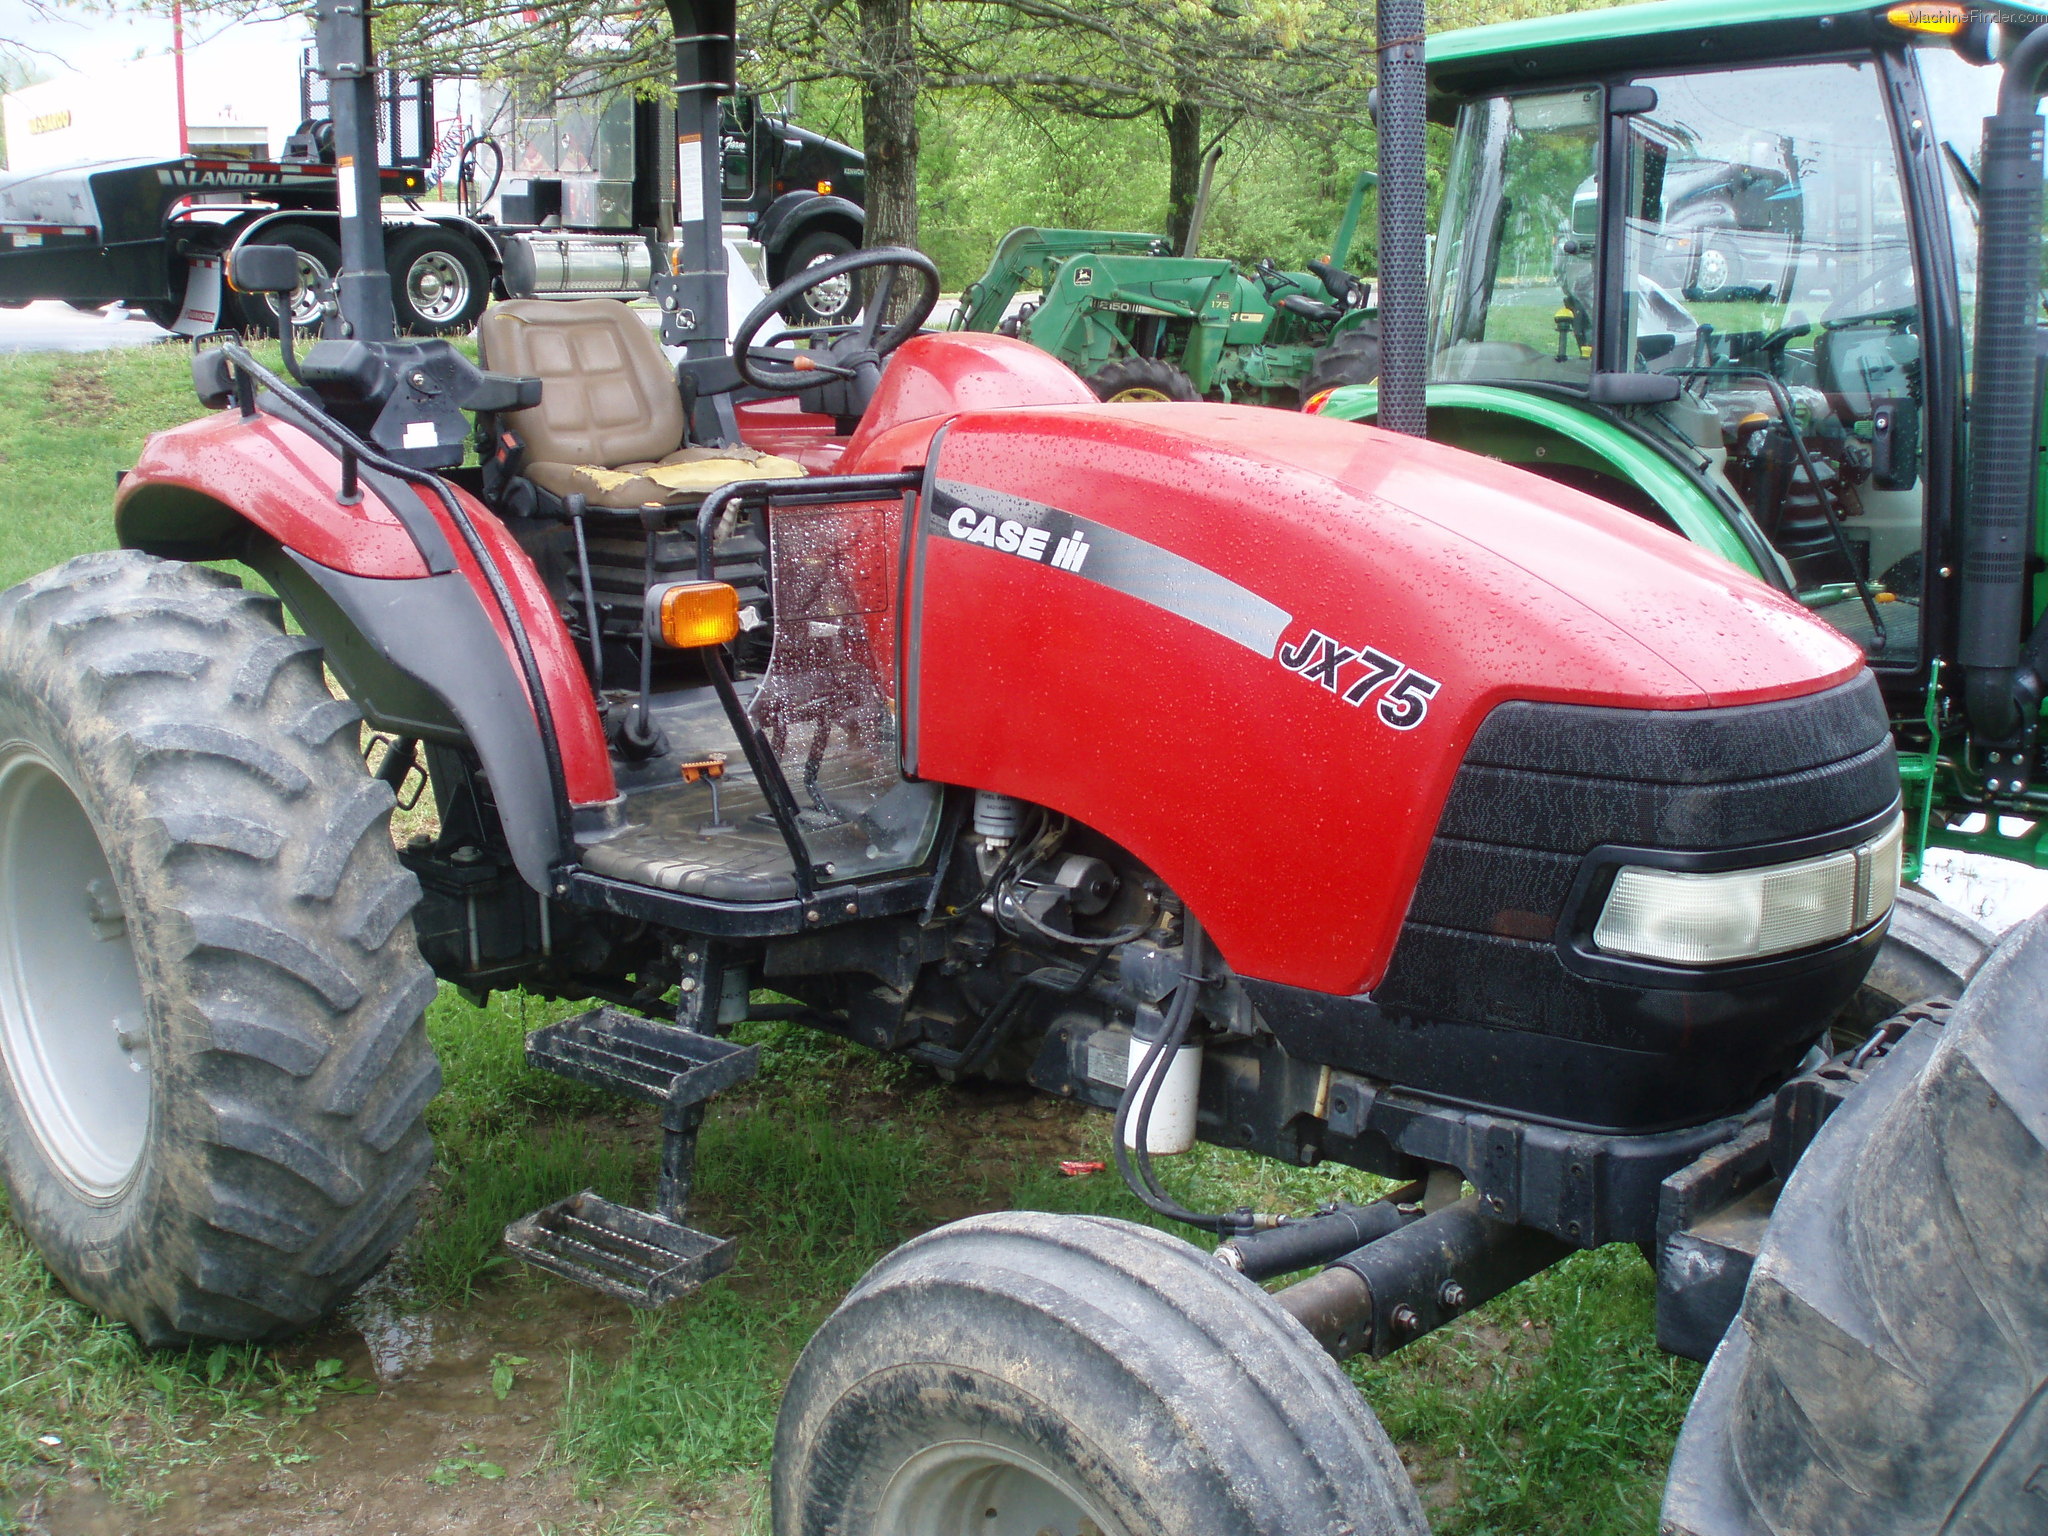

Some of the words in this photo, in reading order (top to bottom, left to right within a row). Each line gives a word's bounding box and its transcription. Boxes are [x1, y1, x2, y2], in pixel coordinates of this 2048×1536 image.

[187, 169, 281, 187] LANDOLL
[1099, 300, 1130, 311] 2150
[1211, 300, 1230, 309] 175
[947, 507, 1051, 561] CASE
[1278, 628, 1442, 731] JX75
